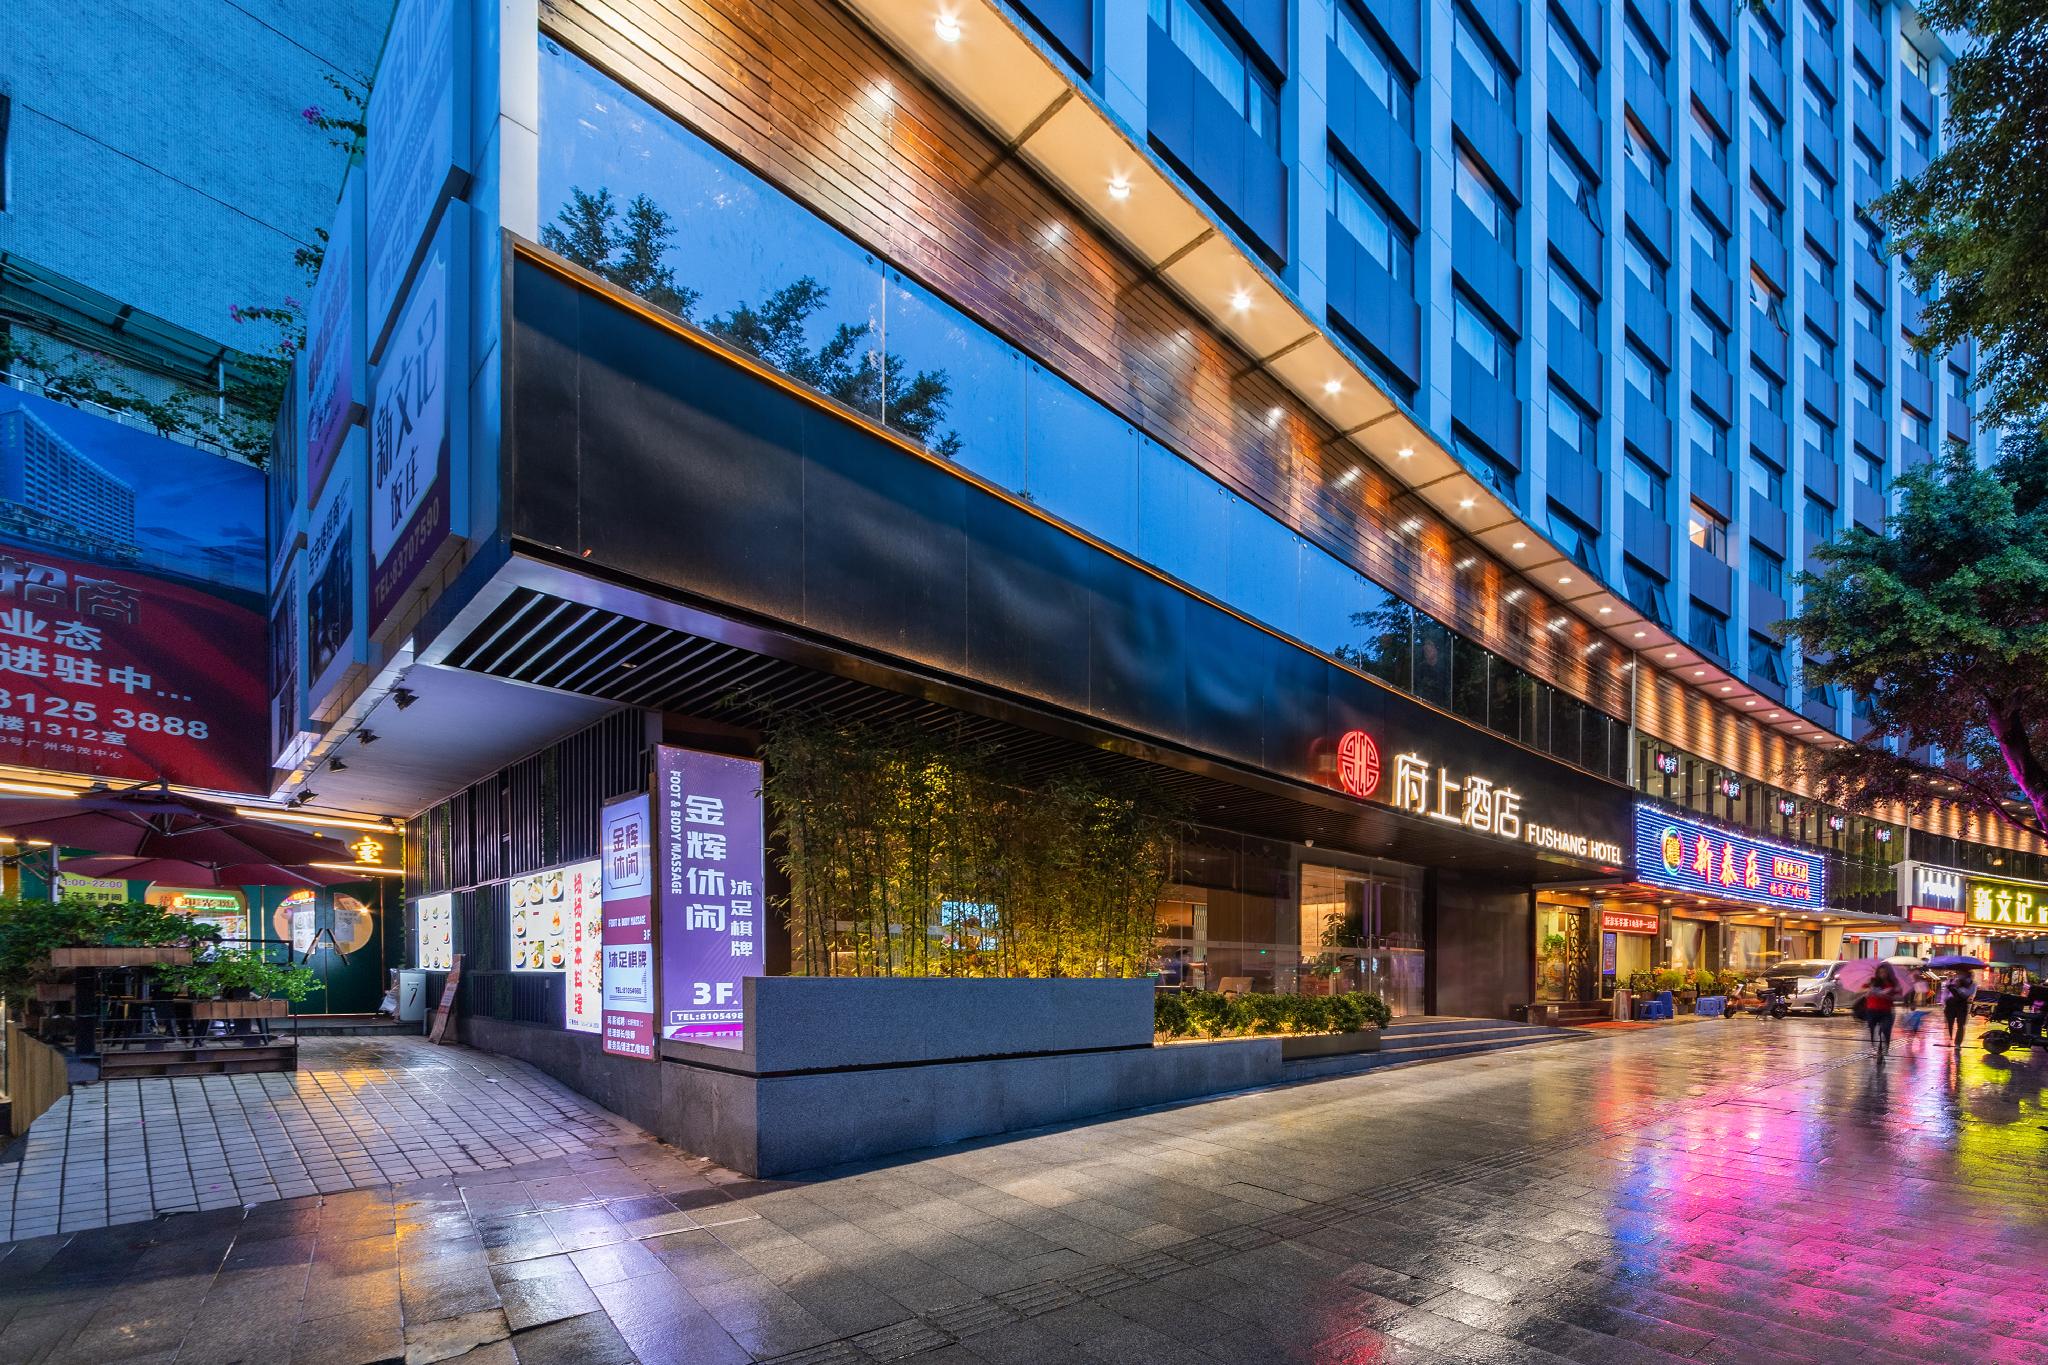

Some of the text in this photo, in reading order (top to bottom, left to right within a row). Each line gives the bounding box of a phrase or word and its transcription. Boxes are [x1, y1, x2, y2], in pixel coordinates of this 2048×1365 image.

[376, 298, 438, 490] 新文记
[391, 445, 419, 531] 饭庄
[0, 554, 143, 625] 招商
[0, 608, 102, 651] 业态
[112, 708, 209, 740] 3888
[1393, 752, 1520, 839] 府上酒店
[613, 822, 638, 852] 金辉
[670, 770, 682, 894] FOOT & BODY MASSAGE
[1526, 823, 1622, 865] FUSHANG HOTEL
[613, 852, 638, 881] 休闲
[684, 794, 727, 933] 金辉休闲
[1692, 834, 1760, 890] 新泰乐
[608, 918, 618, 928] FOOT
[630, 914, 646, 925] MASSAGE
[731, 879, 753, 957] 沐足棋牌
[609, 950, 647, 969] 沐足棋牌
